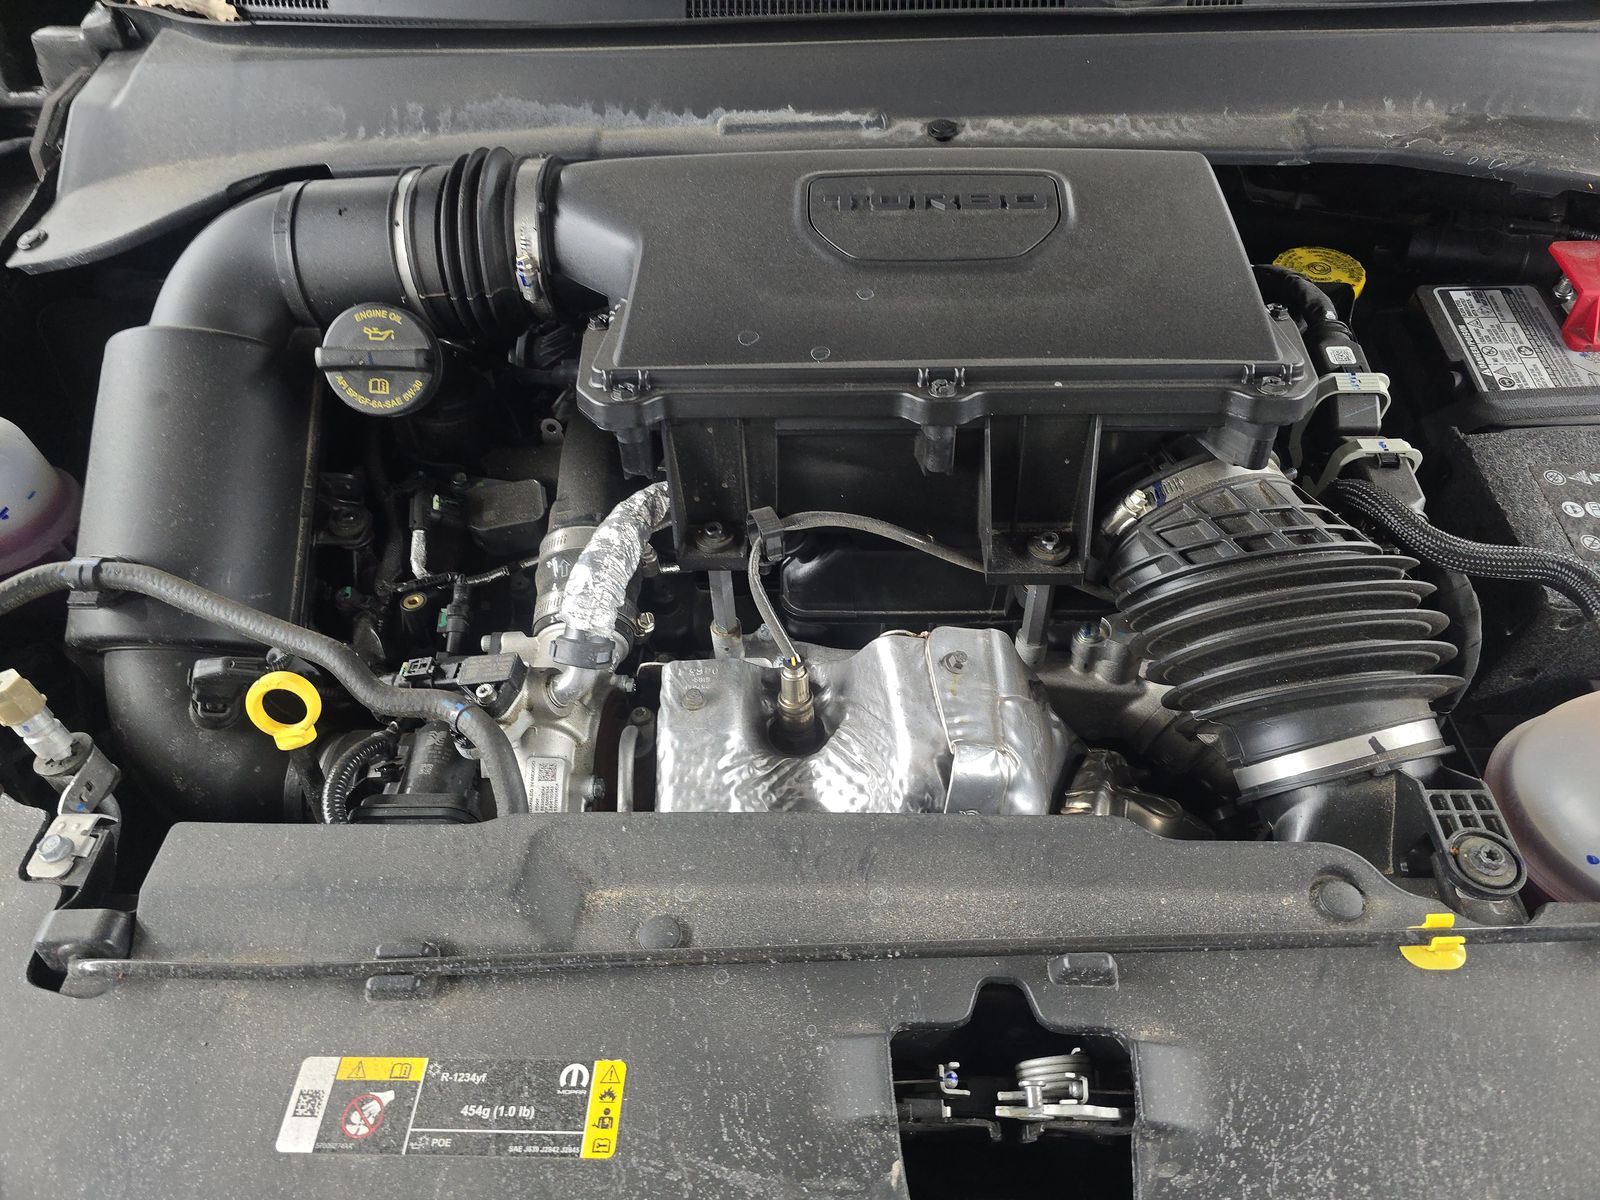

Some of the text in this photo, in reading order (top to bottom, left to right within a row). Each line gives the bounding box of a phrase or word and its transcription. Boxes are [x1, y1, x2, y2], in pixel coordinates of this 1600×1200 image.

[354, 309, 402, 325] ENGINE OIL
[440, 1072, 487, 1085] R-1234yf
[461, 1105, 535, 1119] 454g (1.0 lb)
[431, 1138, 452, 1147] POE
[508, 1145, 523, 1153] SAE
